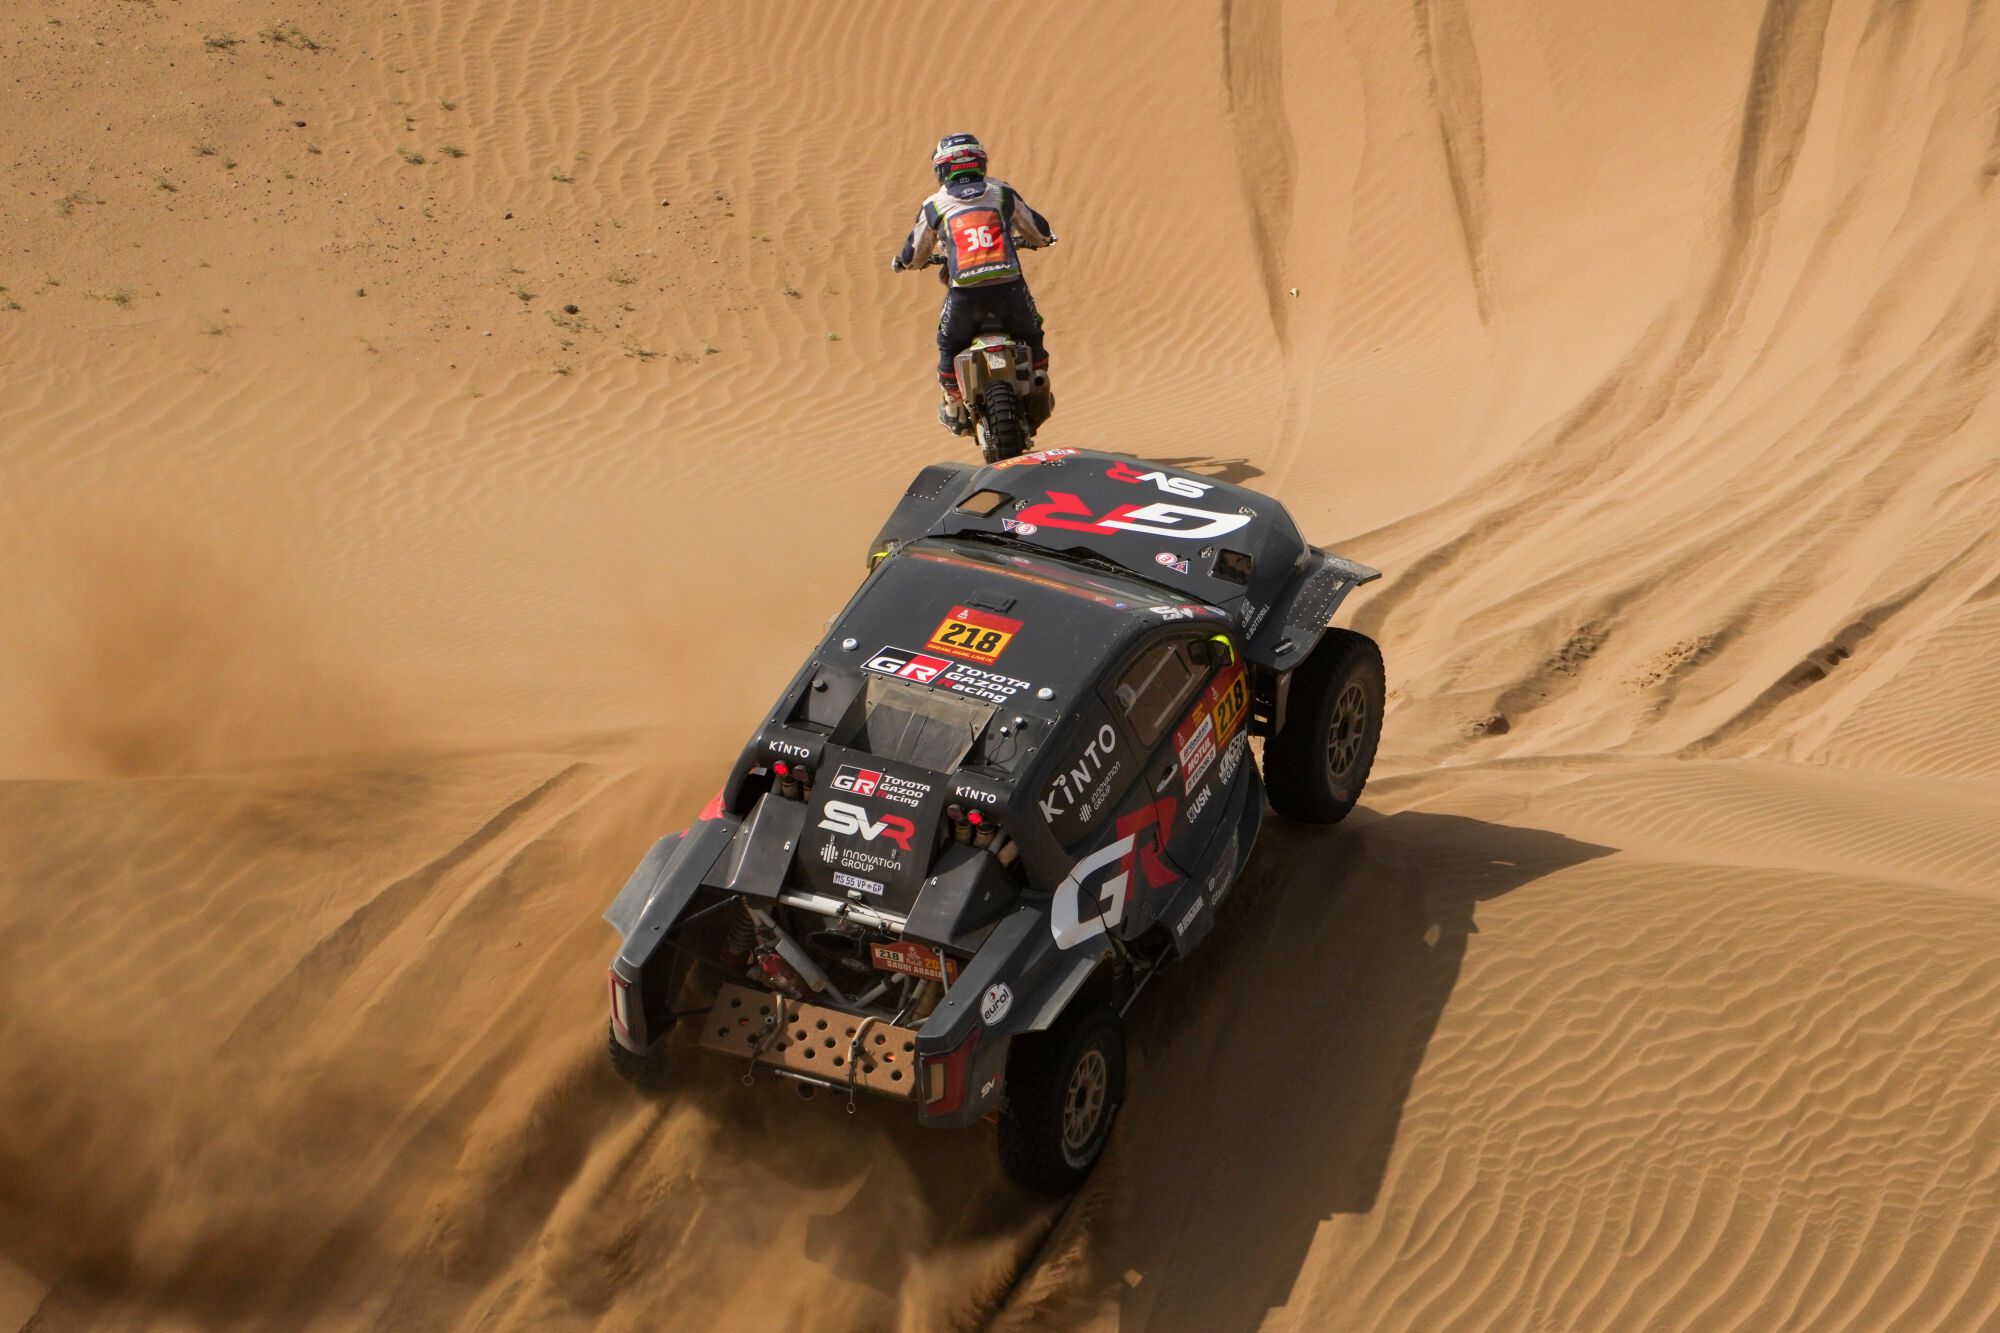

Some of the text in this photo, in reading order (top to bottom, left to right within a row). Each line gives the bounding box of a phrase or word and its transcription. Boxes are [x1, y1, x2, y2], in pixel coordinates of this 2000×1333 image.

[964, 225, 993, 251] 36
[940, 623, 1002, 653] 218
[868, 656, 938, 681] GR
[956, 664, 1031, 690] TOYOTA
[936, 678, 1008, 703] Racing
[945, 671, 1017, 695] GAZOO
[1217, 678, 1244, 734] 218
[1187, 737, 1212, 775] MOTUL
[834, 775, 875, 794] GR
[880, 783, 924, 798] GAZOO
[884, 775, 931, 792] TOYOTA
[876, 790, 919, 808] Racing
[1093, 785, 1111, 810] GROUP
[1193, 784, 1212, 815] USN
[817, 800, 915, 852] SVR
[841, 859, 874, 872] GROUP
[1051, 796, 1182, 950] GR
[846, 875, 855, 885] 55
[856, 877, 866, 887] VP
[872, 883, 883, 893] GP
[879, 950, 900, 960] 218
[924, 959, 953, 973] 206
[887, 960, 944, 979] SAUDI ARABIA
[984, 989, 1010, 1020] eurol
